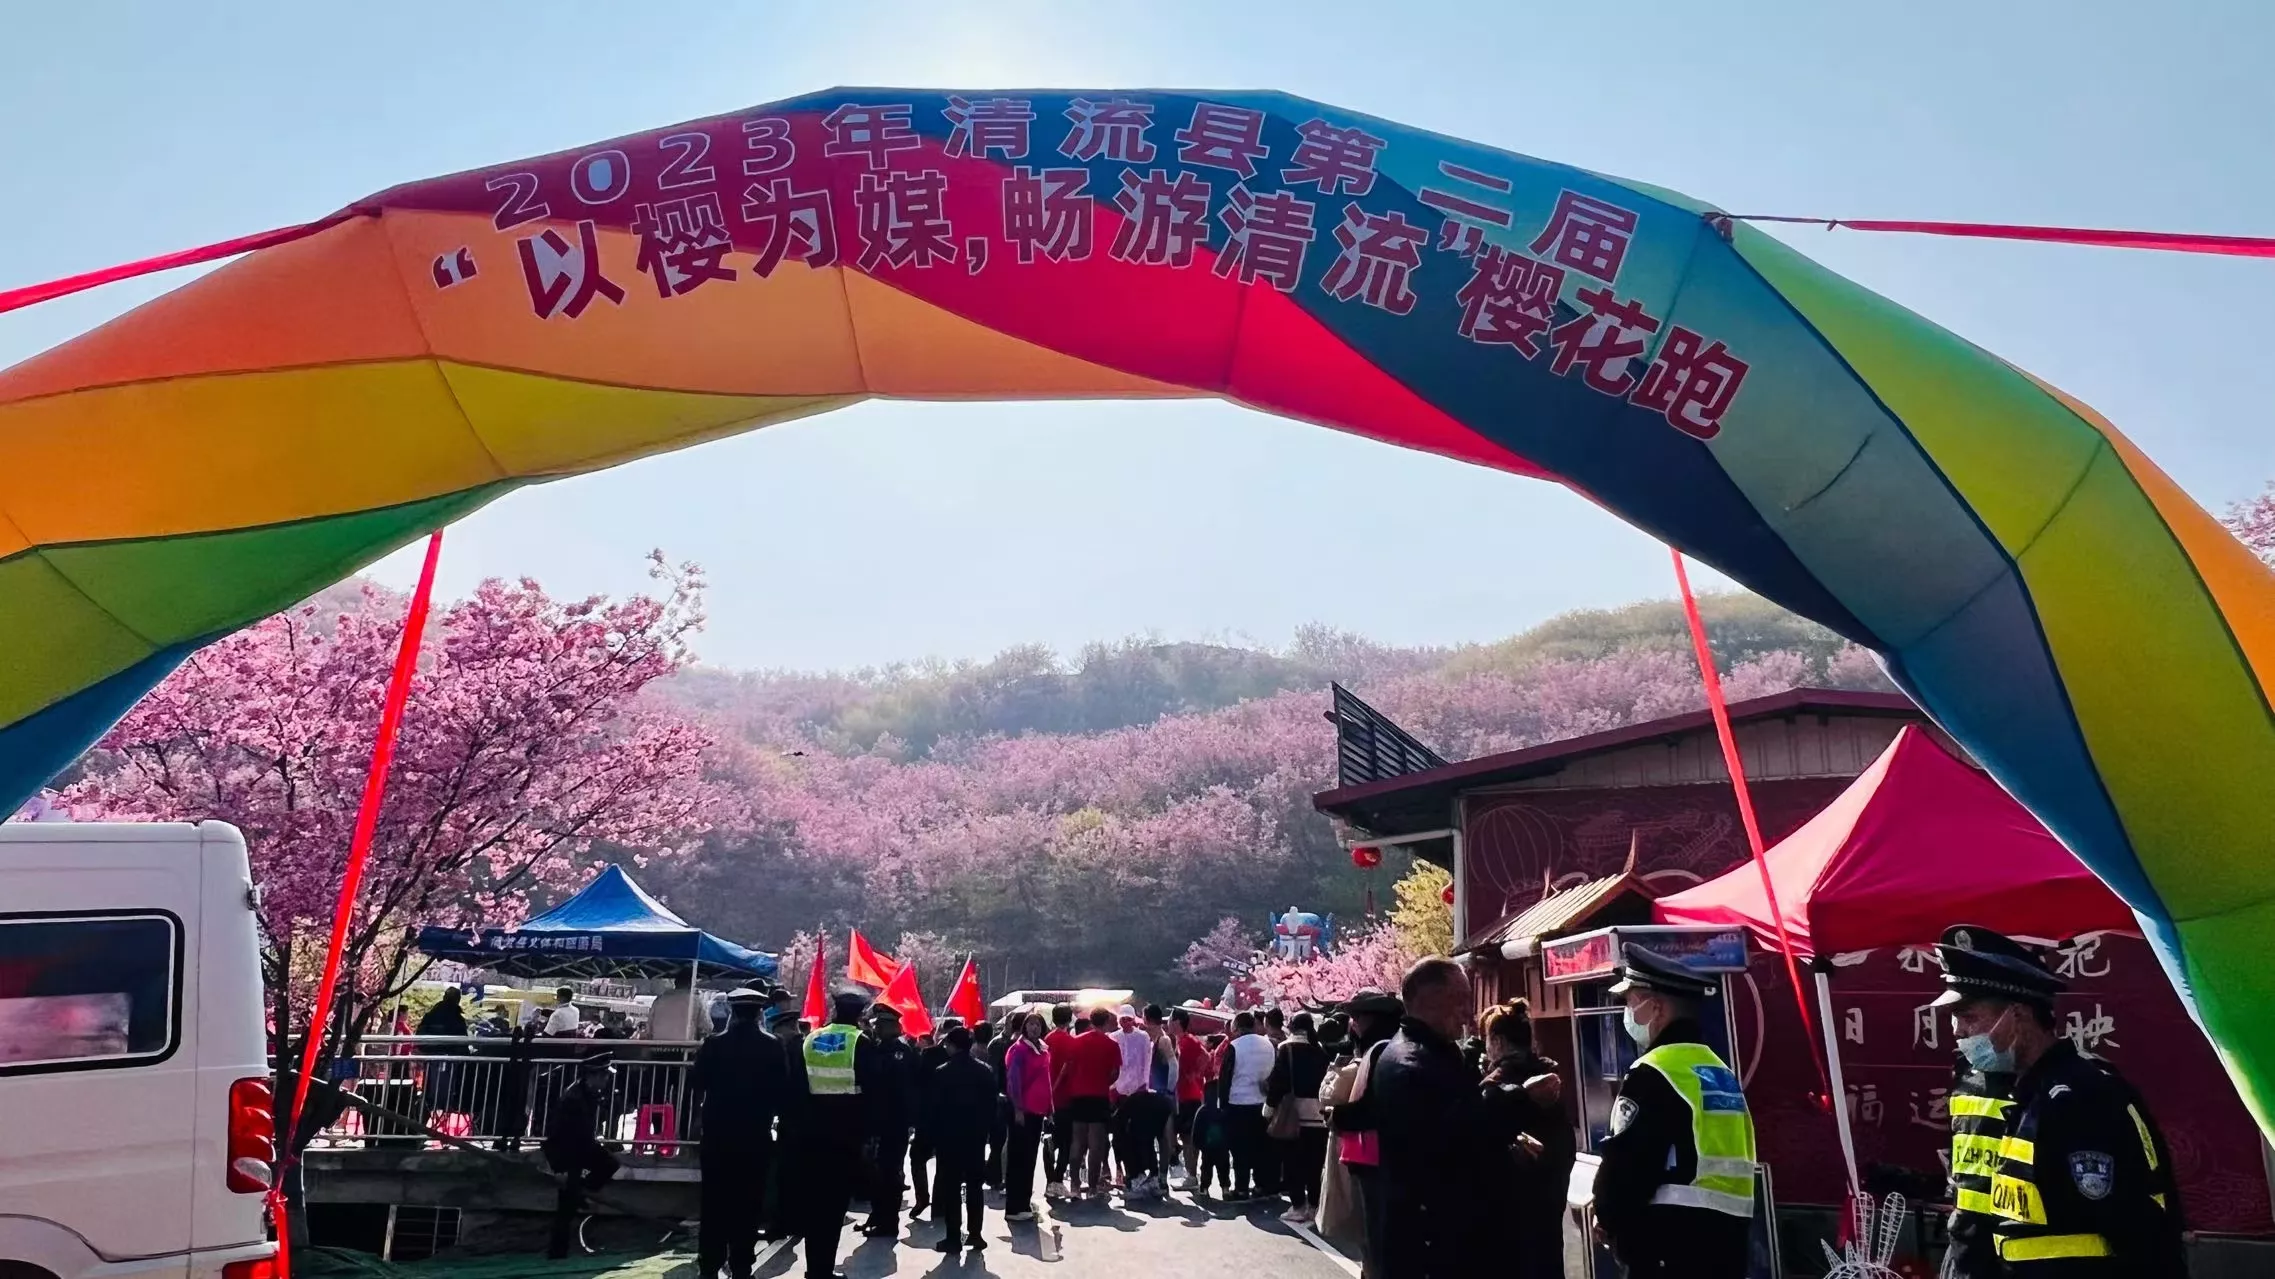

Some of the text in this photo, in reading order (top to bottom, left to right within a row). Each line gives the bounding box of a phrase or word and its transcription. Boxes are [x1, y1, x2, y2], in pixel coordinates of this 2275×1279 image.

[486, 95, 1640, 287] 2023年清流县第二届
